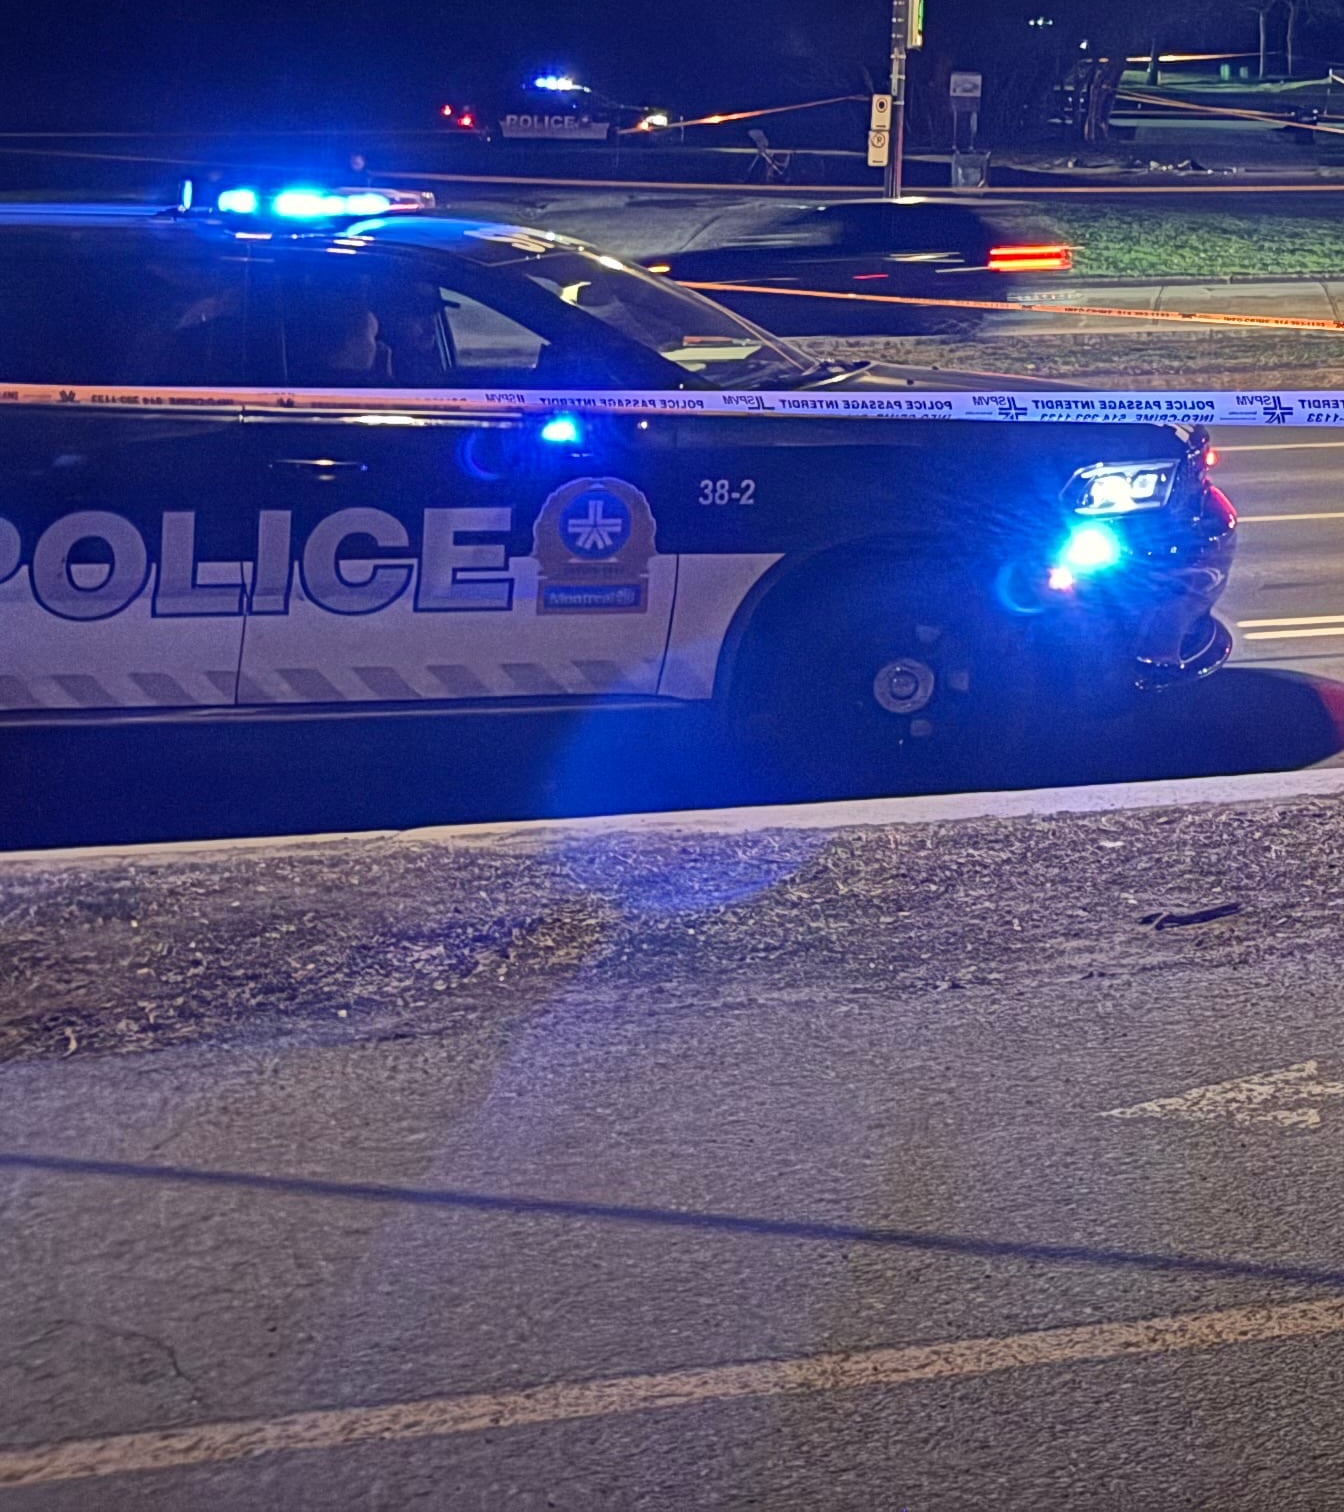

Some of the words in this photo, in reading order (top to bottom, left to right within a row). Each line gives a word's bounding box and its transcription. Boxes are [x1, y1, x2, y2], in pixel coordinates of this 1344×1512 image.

[506, 115, 575, 128] POLICE
[698, 479, 755, 505] 38-2
[0, 507, 514, 621] OLICE
